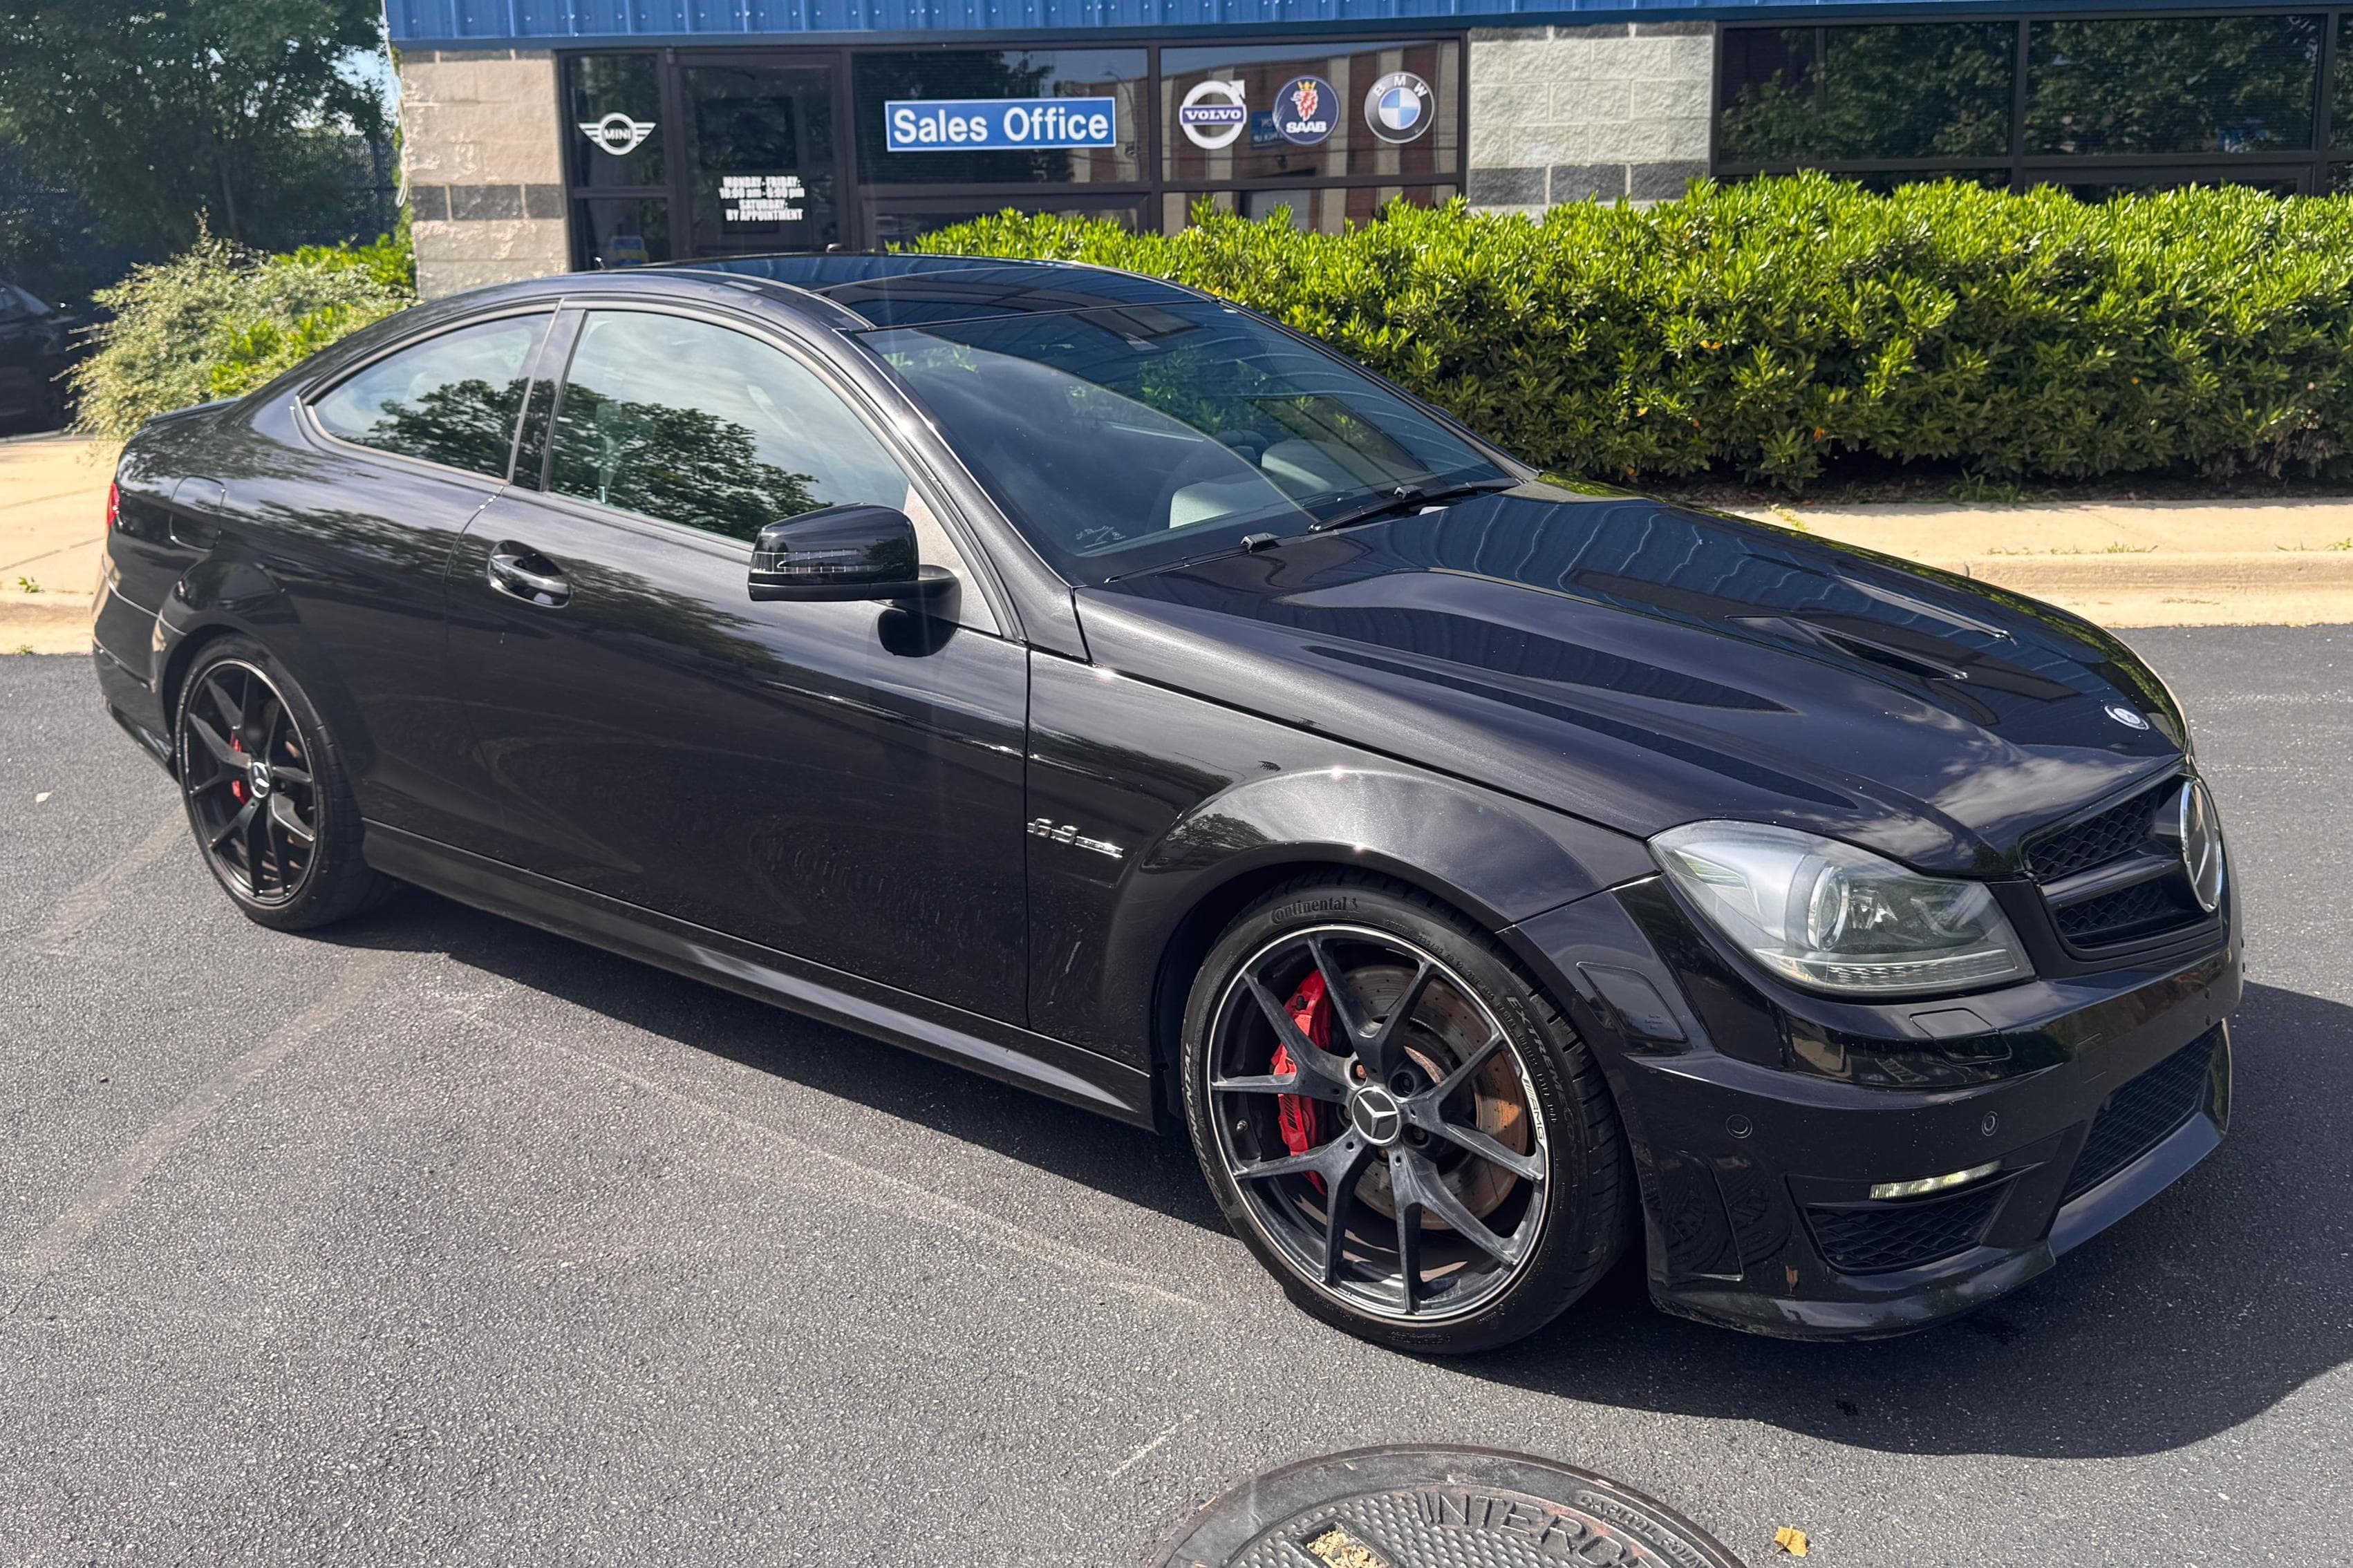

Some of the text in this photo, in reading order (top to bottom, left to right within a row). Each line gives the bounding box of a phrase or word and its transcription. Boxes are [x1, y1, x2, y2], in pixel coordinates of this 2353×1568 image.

[1372, 75, 1428, 97] BMW
[1184, 109, 1242, 121] VOLVO
[894, 106, 1109, 143] Sales Office
[1286, 121, 1327, 133] SAAB
[604, 128, 630, 140] MINI
[722, 176, 762, 187] MONDAY
[725, 209, 803, 221] BY APPOINTMENT
[1271, 896, 1347, 925] Continental
